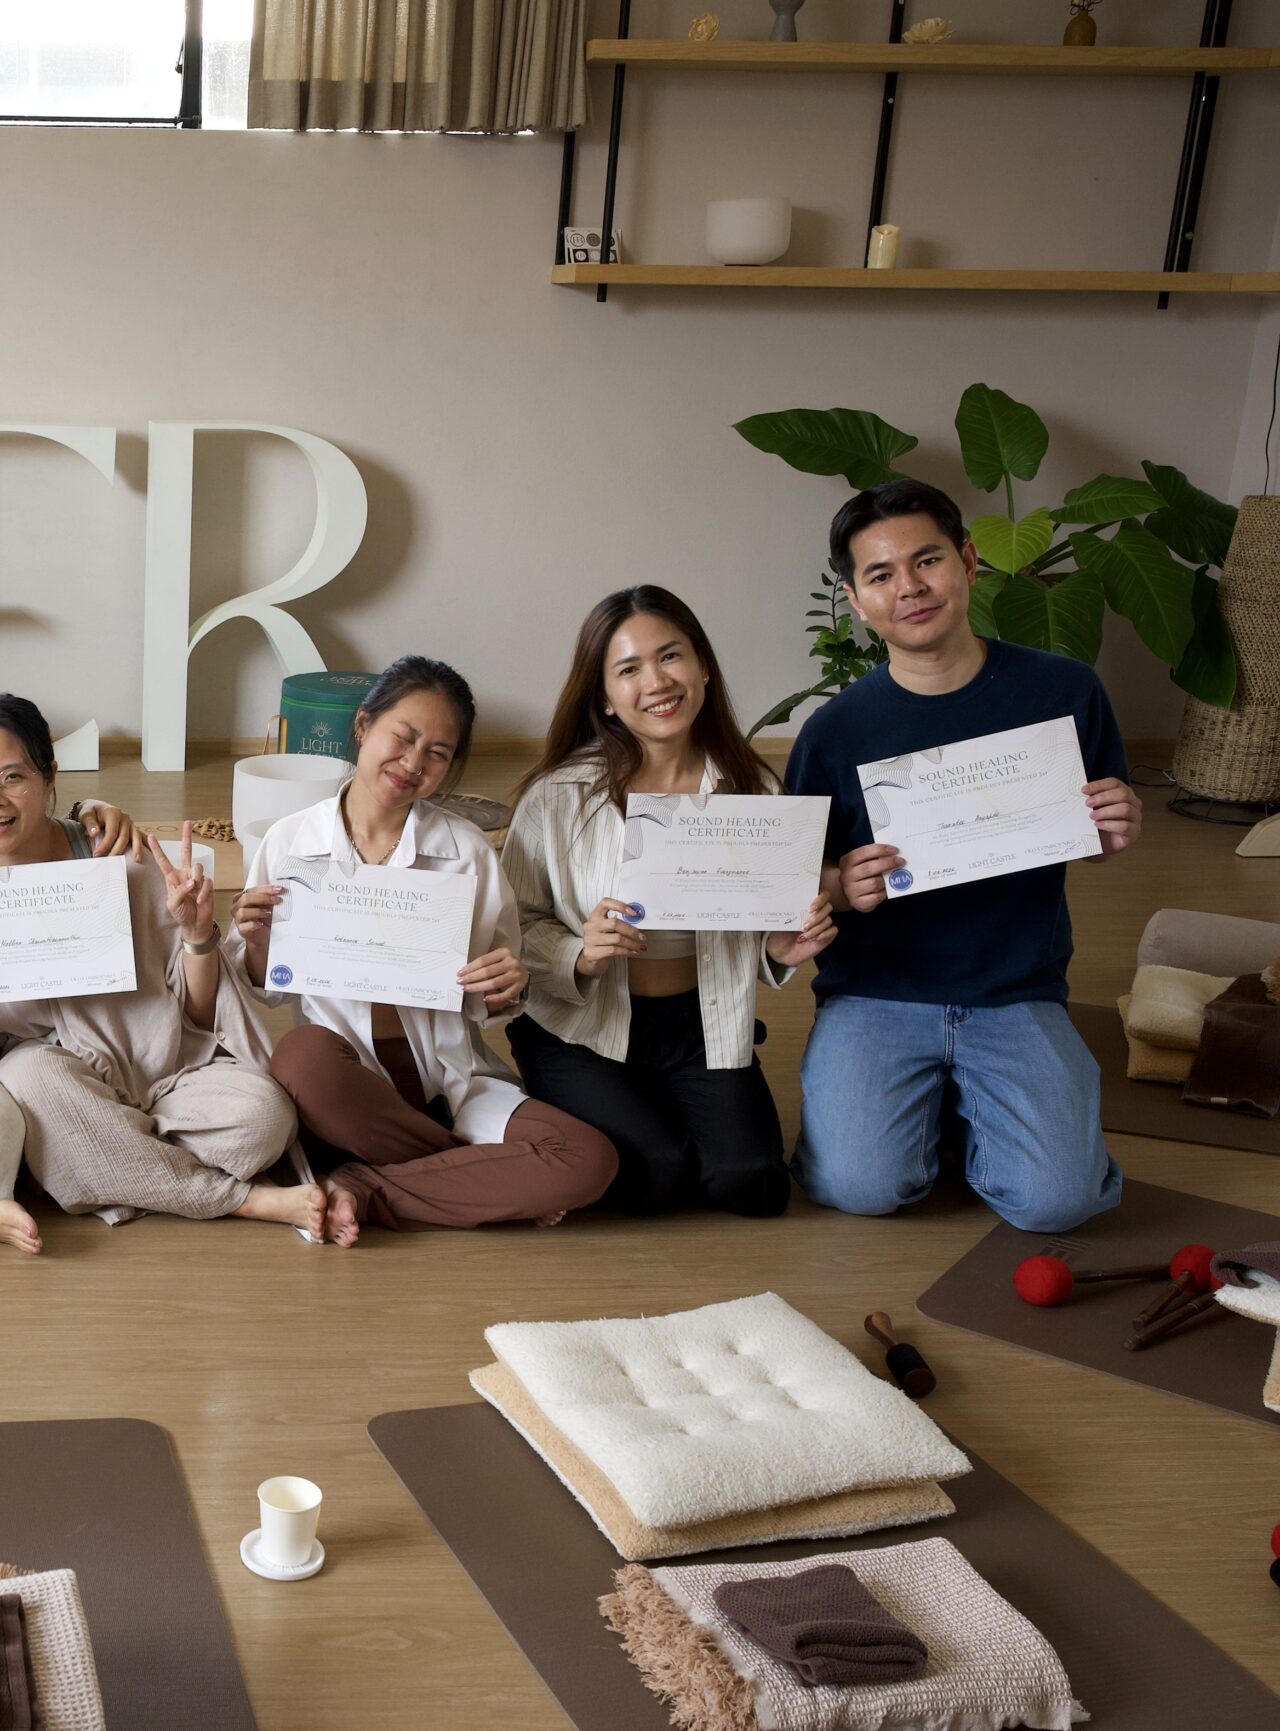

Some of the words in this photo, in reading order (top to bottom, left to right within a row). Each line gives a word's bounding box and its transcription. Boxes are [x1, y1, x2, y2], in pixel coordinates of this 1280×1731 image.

[301, 737, 342, 754] LIGHT
[917, 765, 965, 784] SOUND
[968, 750, 1028, 772] HEALING
[931, 764, 1020, 792] CERTIFICATE
[678, 816, 723, 826] SOUND
[726, 817, 781, 827] HEALING
[687, 827, 769, 838] CERTIFICATE
[31, 882, 84, 896] HEALING
[327, 882, 371, 895] SOUND
[374, 887, 429, 902] HEALING
[336, 895, 417, 912] CERTIFICATE
